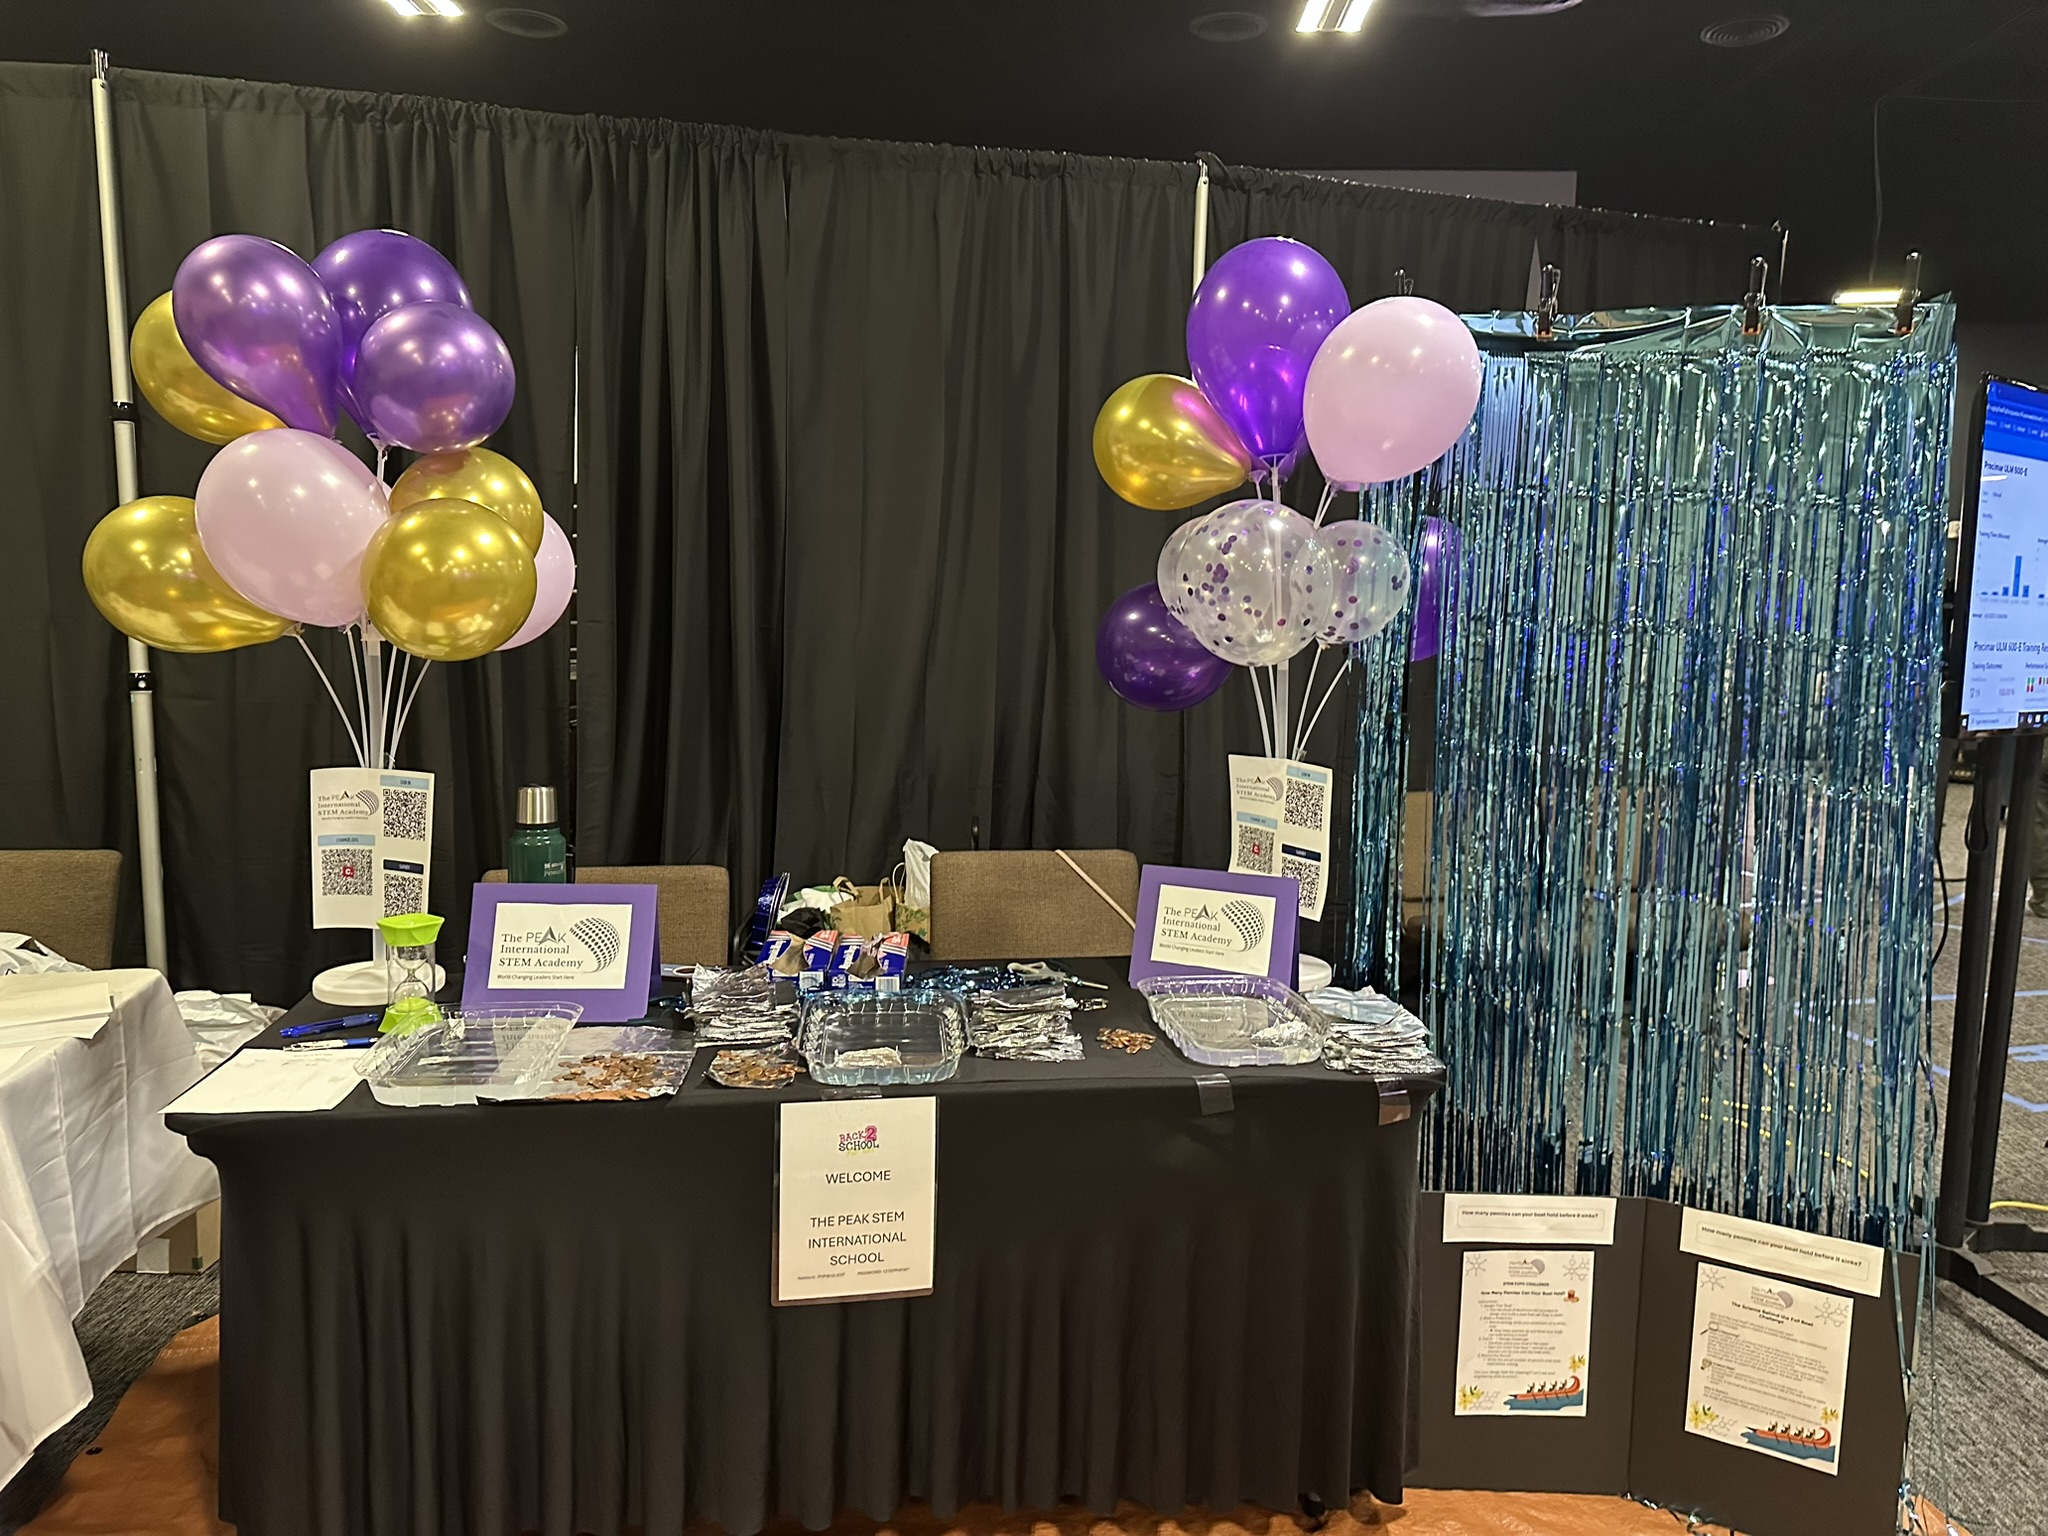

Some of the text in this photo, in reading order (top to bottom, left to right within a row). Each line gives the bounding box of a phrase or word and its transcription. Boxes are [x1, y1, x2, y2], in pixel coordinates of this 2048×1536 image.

[339, 808, 369, 816] Academy
[1164, 904, 1219, 921] The PEAK
[1162, 916, 1221, 931] International
[502, 926, 567, 946] The PEAK
[1161, 928, 1232, 947] STEM Academy
[500, 945, 569, 954] International
[498, 958, 584, 969] STEM Academy
[839, 1125, 878, 1143] BACK 2
[838, 1140, 880, 1152] SCHOOL
[825, 1169, 892, 1184] WELCOME
[810, 1211, 905, 1228] THE PEAK STEM
[808, 1231, 907, 1249] INTERNATIONAL
[1716, 1230, 1732, 1239] many
[1733, 1234, 1757, 1243] pennies
[1799, 1248, 1814, 1256] hold
[1814, 1251, 1835, 1261] before
[1841, 1258, 1862, 1267] sinks?
[829, 1252, 885, 1266] SCHOOL
